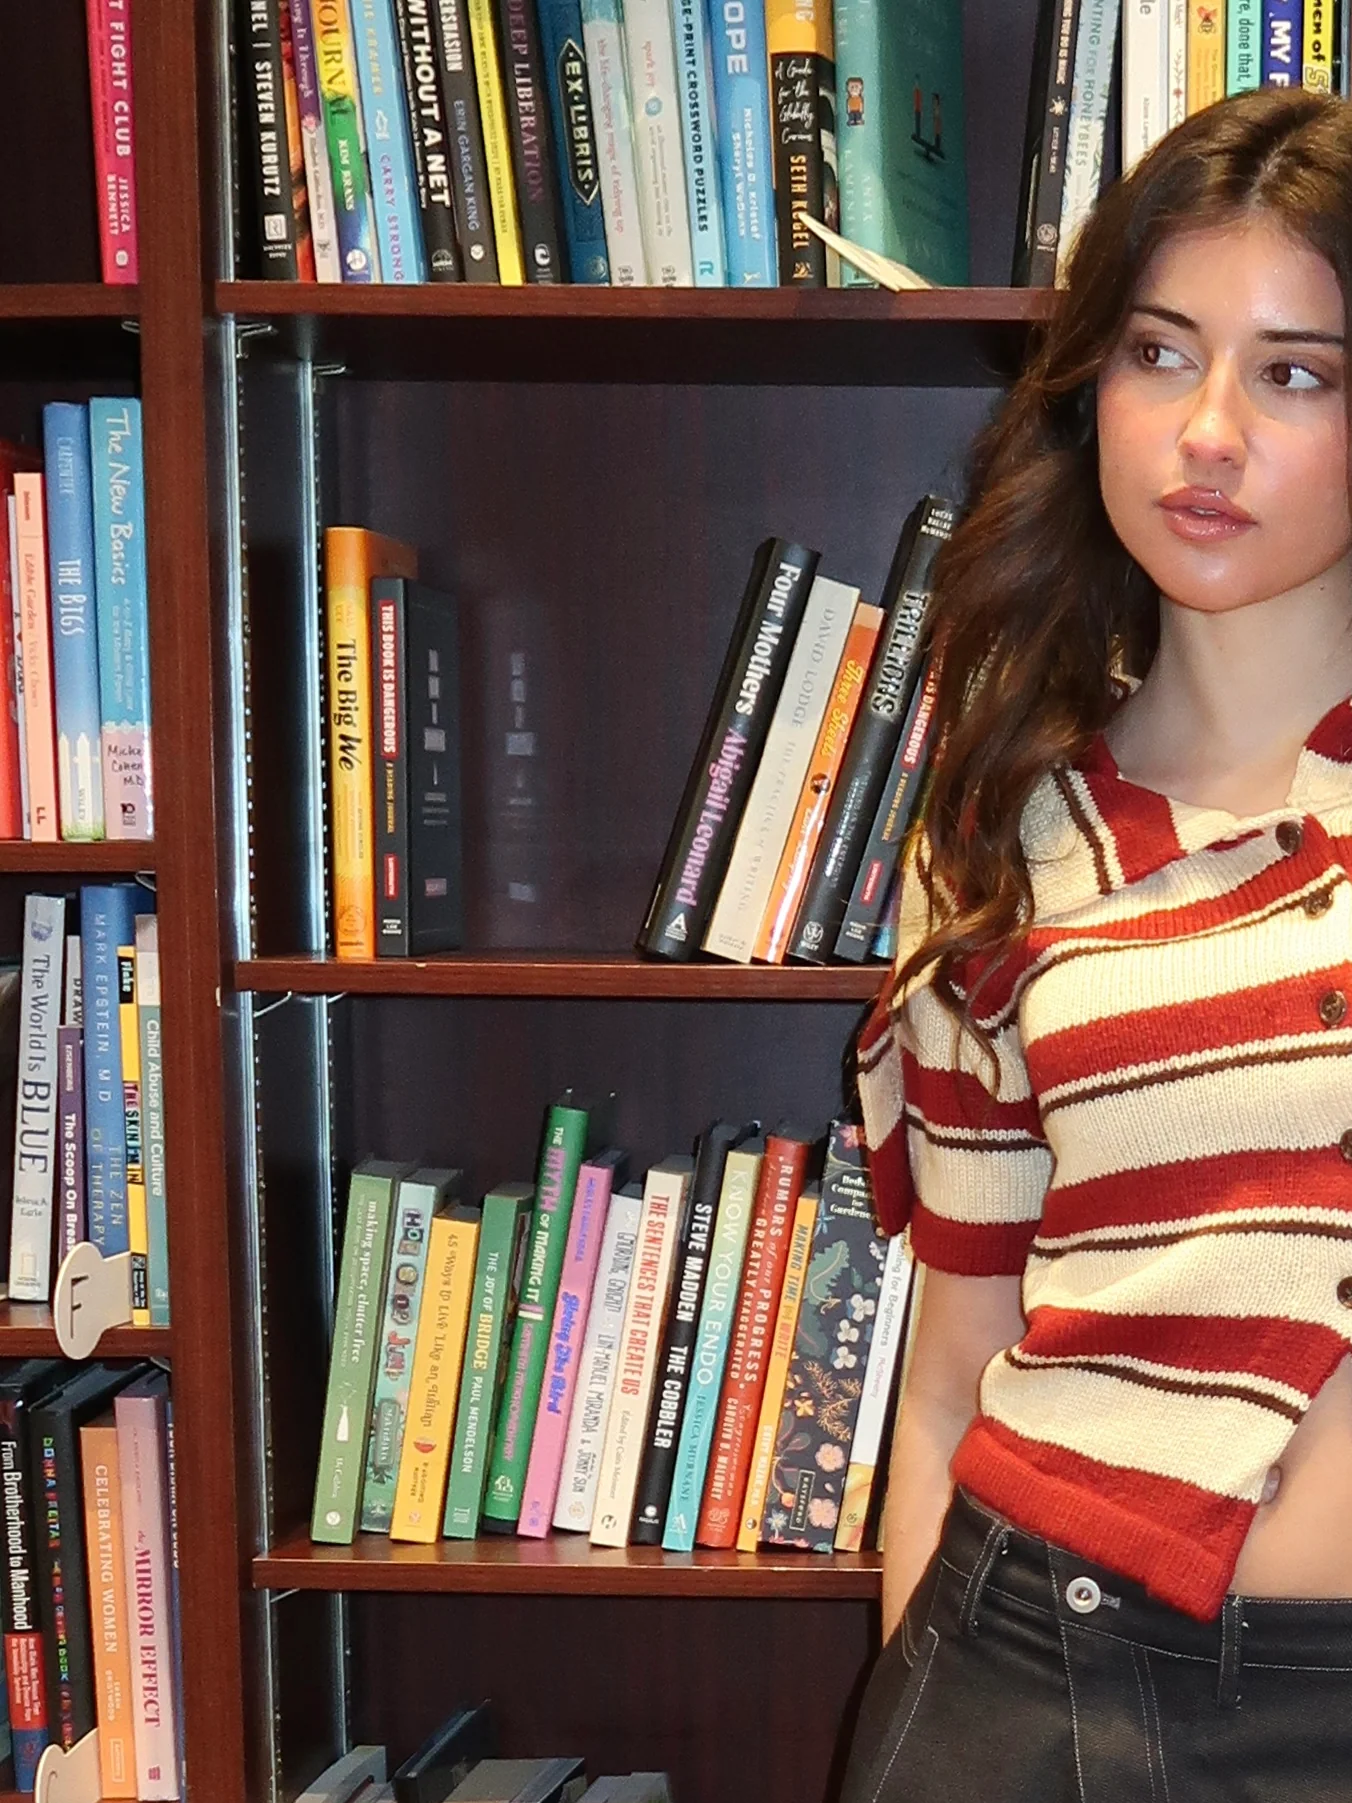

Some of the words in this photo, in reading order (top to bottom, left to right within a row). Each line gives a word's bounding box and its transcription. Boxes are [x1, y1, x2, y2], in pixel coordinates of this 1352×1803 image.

[110, 21, 128, 89] FIGHT
[408, 0, 440, 121] WITHOUT
[255, 62, 276, 126] STEVEN
[113, 101, 130, 156] CLUB
[424, 128, 441, 146] A
[260, 132, 280, 196] KURUTZ
[427, 154, 450, 207] NET
[106, 175, 120, 235] BENNETT
[118, 177, 131, 232] JESSICA
[106, 408, 129, 455] The
[108, 463, 129, 513] New
[109, 522, 132, 584] Basics
[767, 562, 802, 616] Four
[335, 640, 357, 684] The
[733, 621, 782, 716] Mothers
[333, 688, 358, 727] Big
[336, 733, 362, 772] We
[704, 729, 748, 811] Abigail
[676, 811, 721, 905] Leonard
[31, 955, 51, 991] The
[29, 995, 49, 1052] World
[147, 1020, 161, 1059] Child
[28, 1056, 46, 1072] Is
[148, 1062, 162, 1108] Abuse
[18, 1079, 51, 1173] BLUE
[150, 1111, 162, 1139] and
[150, 1143, 163, 1196] Culture
[688, 1203, 711, 1250] STEVE
[484, 1275, 496, 1294] JOY
[487, 1252, 498, 1271] THE
[482, 1297, 493, 1310] OF
[677, 1257, 704, 1322] MADDEN
[474, 1314, 493, 1369] BRIDGE
[668, 1345, 687, 1375] THE
[470, 1376, 483, 1403] PAUL
[653, 1380, 681, 1449] COBBLER
[1, 1442, 16, 1469] From
[461, 1406, 479, 1472] MENDELSON
[3, 1472, 27, 1554] Brotherhood
[95, 1465, 114, 1583] CELEBRATING
[9, 1556, 20, 1566] to
[10, 1569, 31, 1630] Manhood
[102, 1588, 117, 1653] WOMEN
